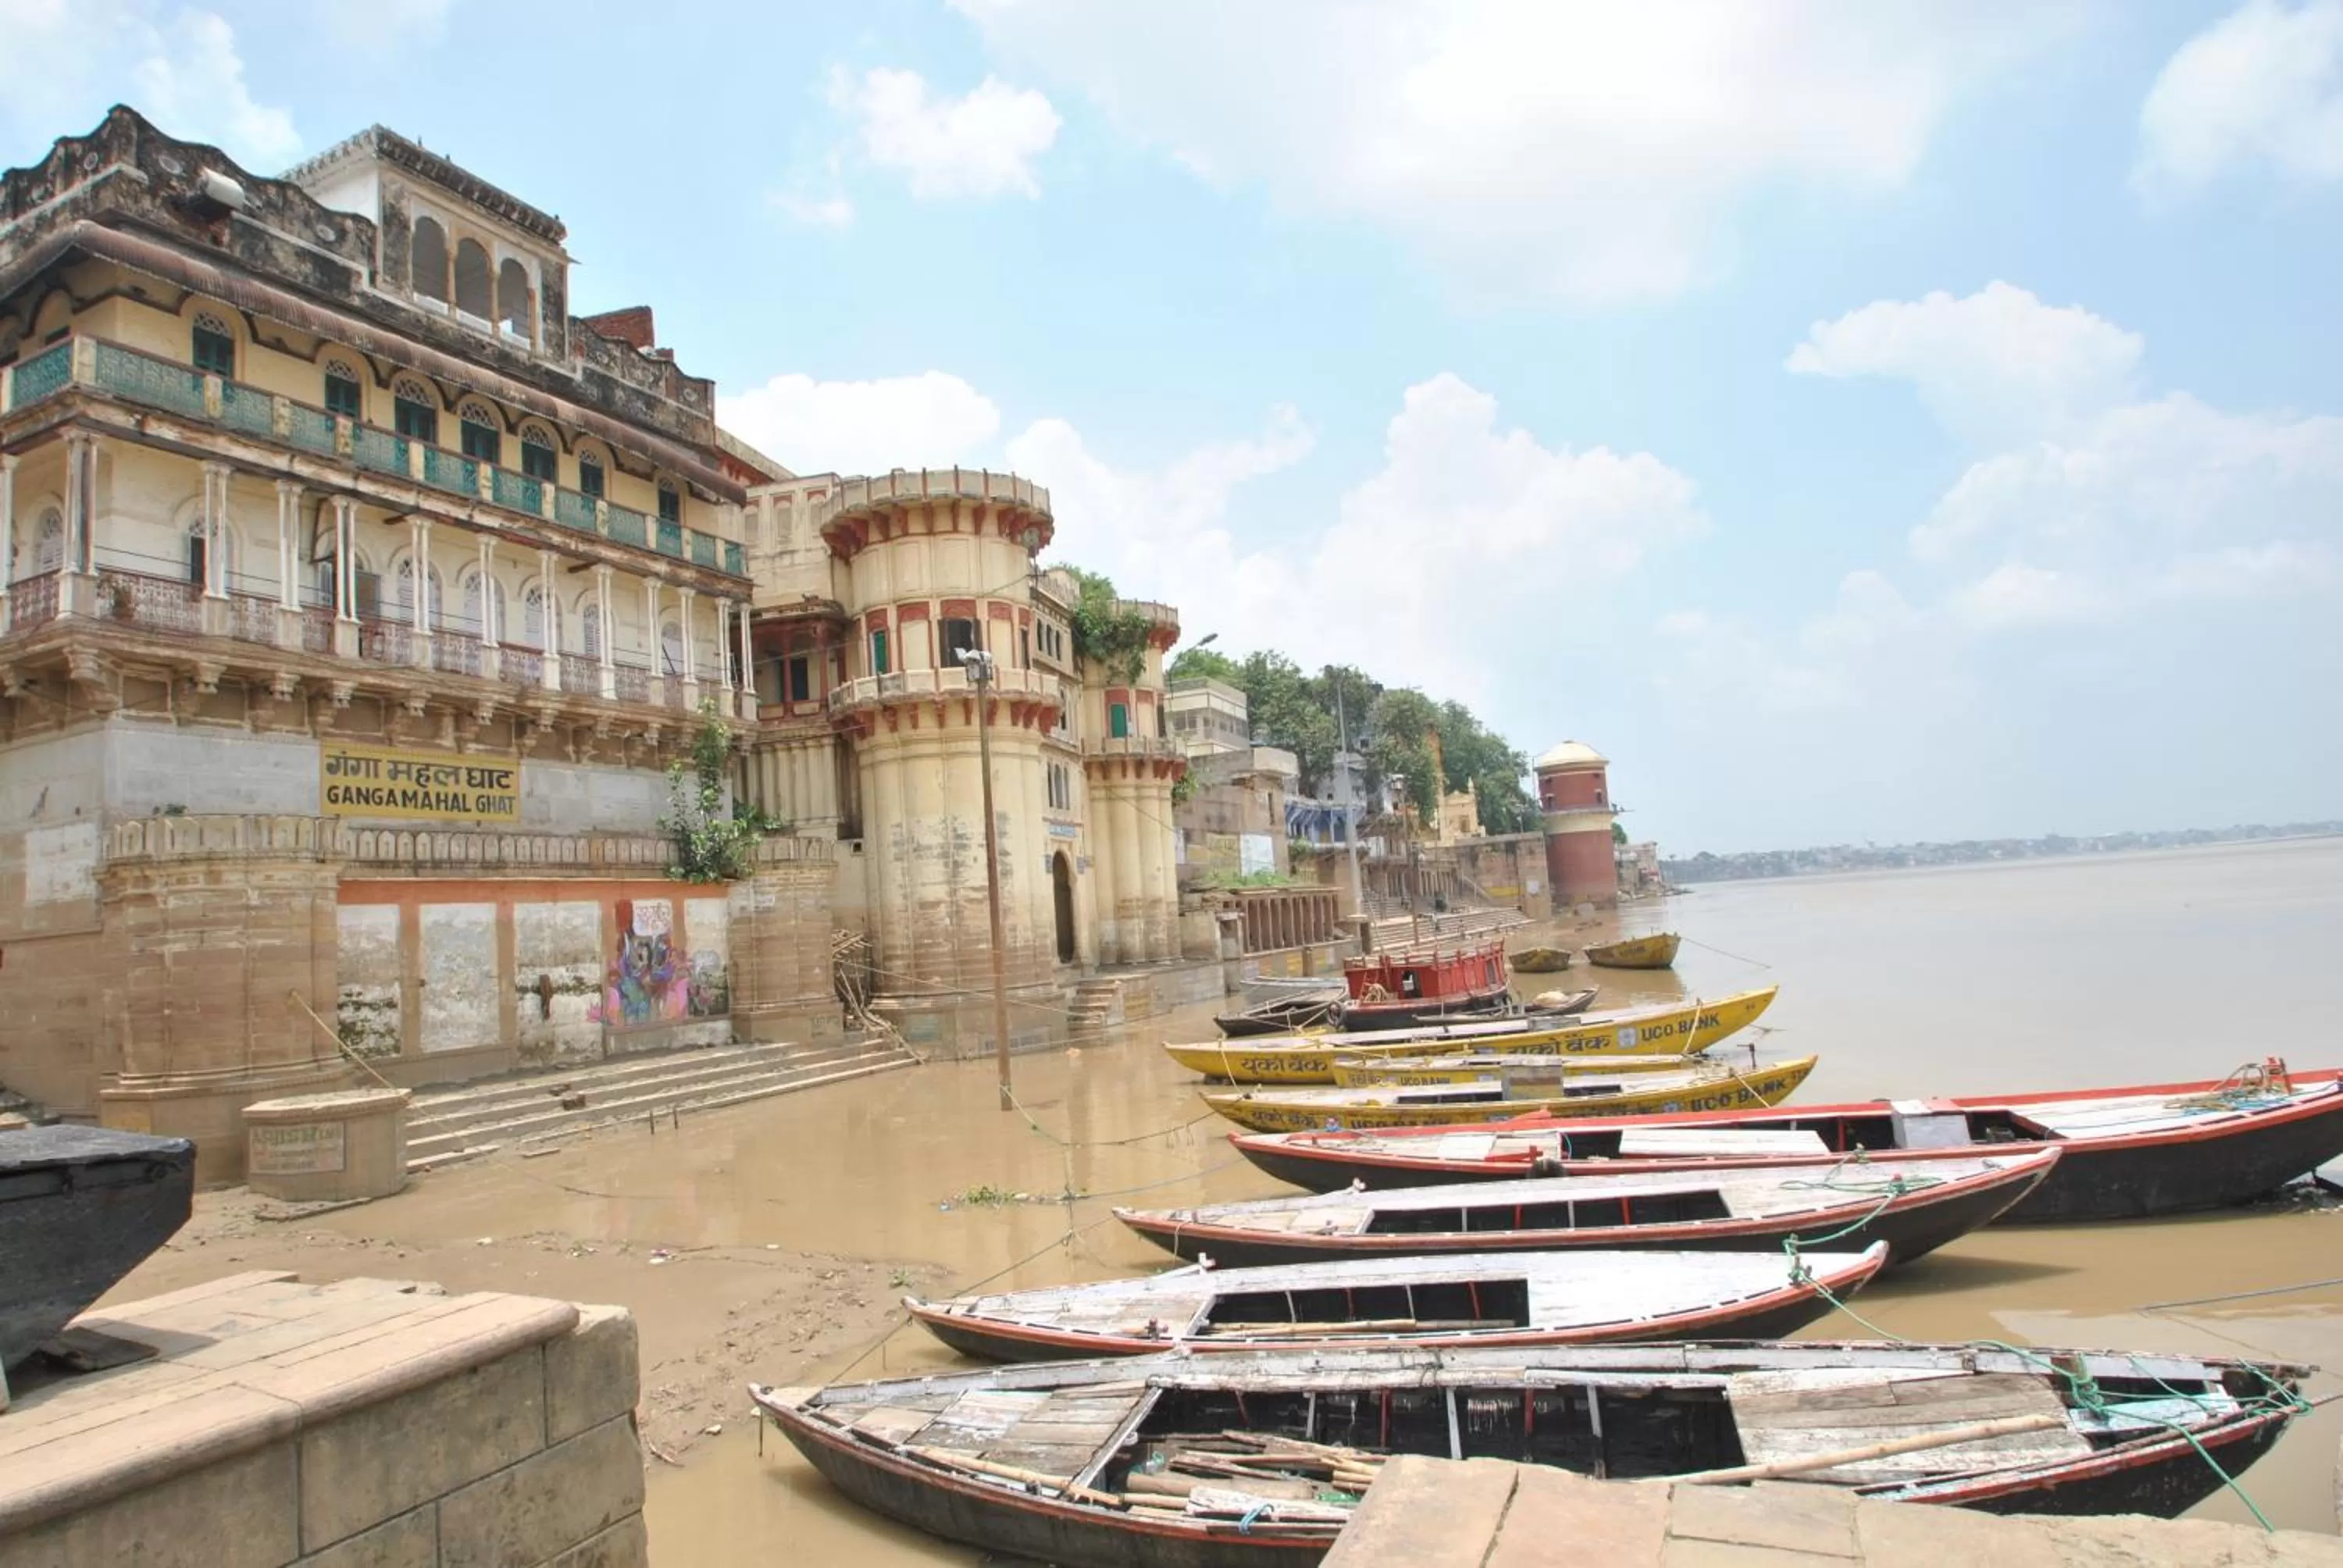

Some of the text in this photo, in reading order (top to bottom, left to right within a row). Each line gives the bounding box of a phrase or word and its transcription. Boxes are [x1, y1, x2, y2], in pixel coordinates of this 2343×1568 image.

[325, 750, 514, 789] गंगा महल घाट
[476, 794, 515, 815] GHAT
[1641, 1014, 1721, 1042] UCO BANK
[1691, 1094, 1731, 1112] UCO
